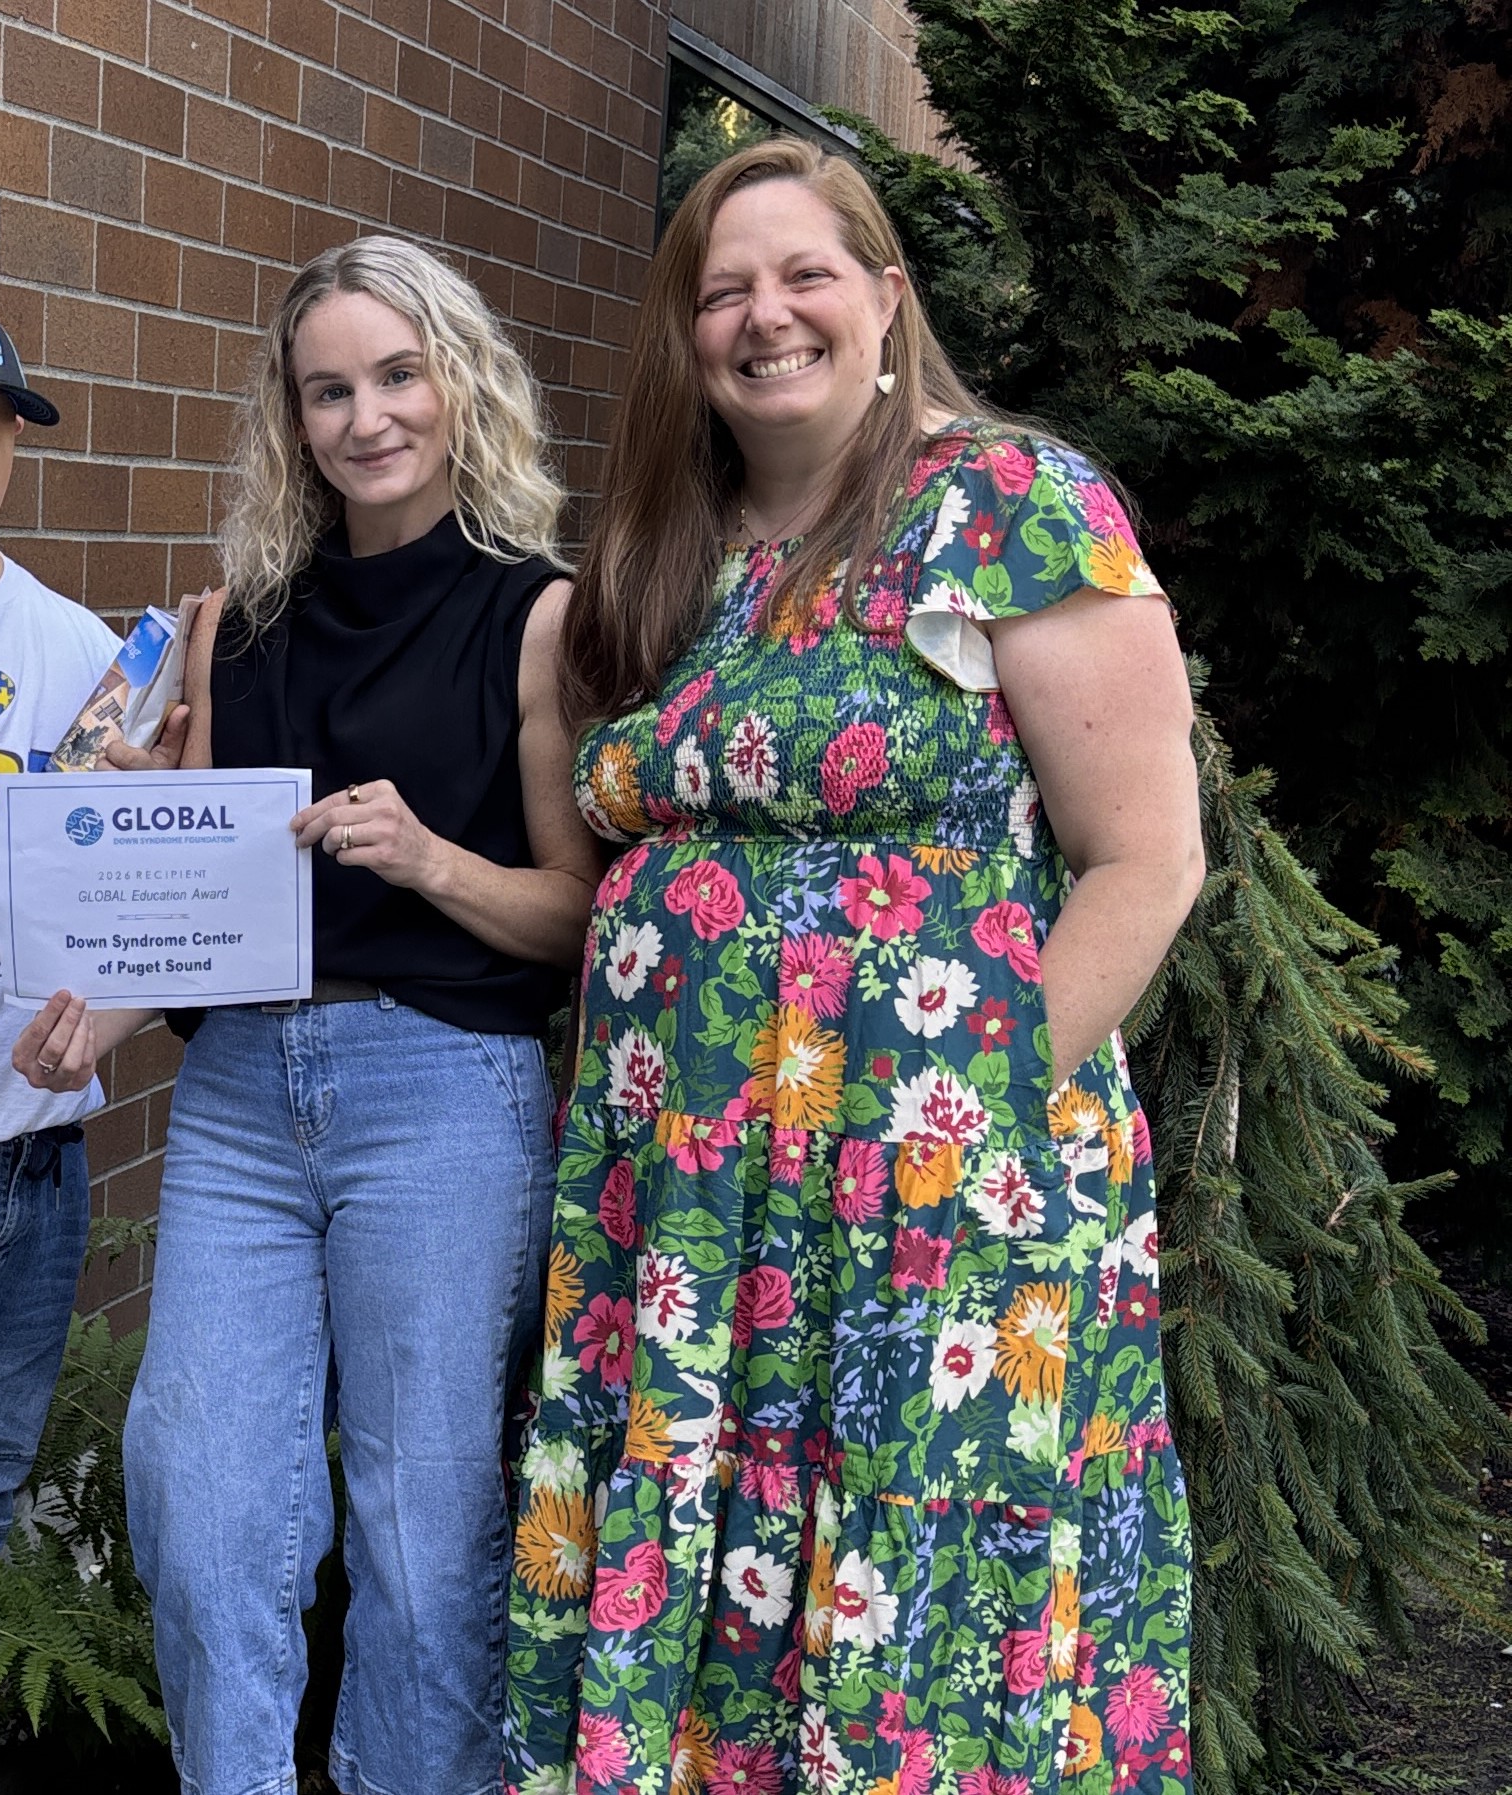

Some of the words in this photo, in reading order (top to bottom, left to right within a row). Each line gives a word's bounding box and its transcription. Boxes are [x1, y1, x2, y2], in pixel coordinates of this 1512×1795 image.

[112, 805, 235, 832] GLOBAL
[113, 837, 138, 846] DOWN
[139, 836, 184, 845] SYNDROME
[98, 871, 131, 881] 2026
[136, 869, 207, 880] RECIPIENT
[78, 889, 127, 902] GLOBAL
[131, 888, 187, 902] Education
[191, 887, 230, 900] Award
[65, 934, 107, 949] Down
[112, 933, 188, 951] Syndrome
[192, 931, 244, 946] Center
[98, 961, 113, 975] of
[117, 960, 161, 977] Puget
[165, 957, 212, 973] Sound
